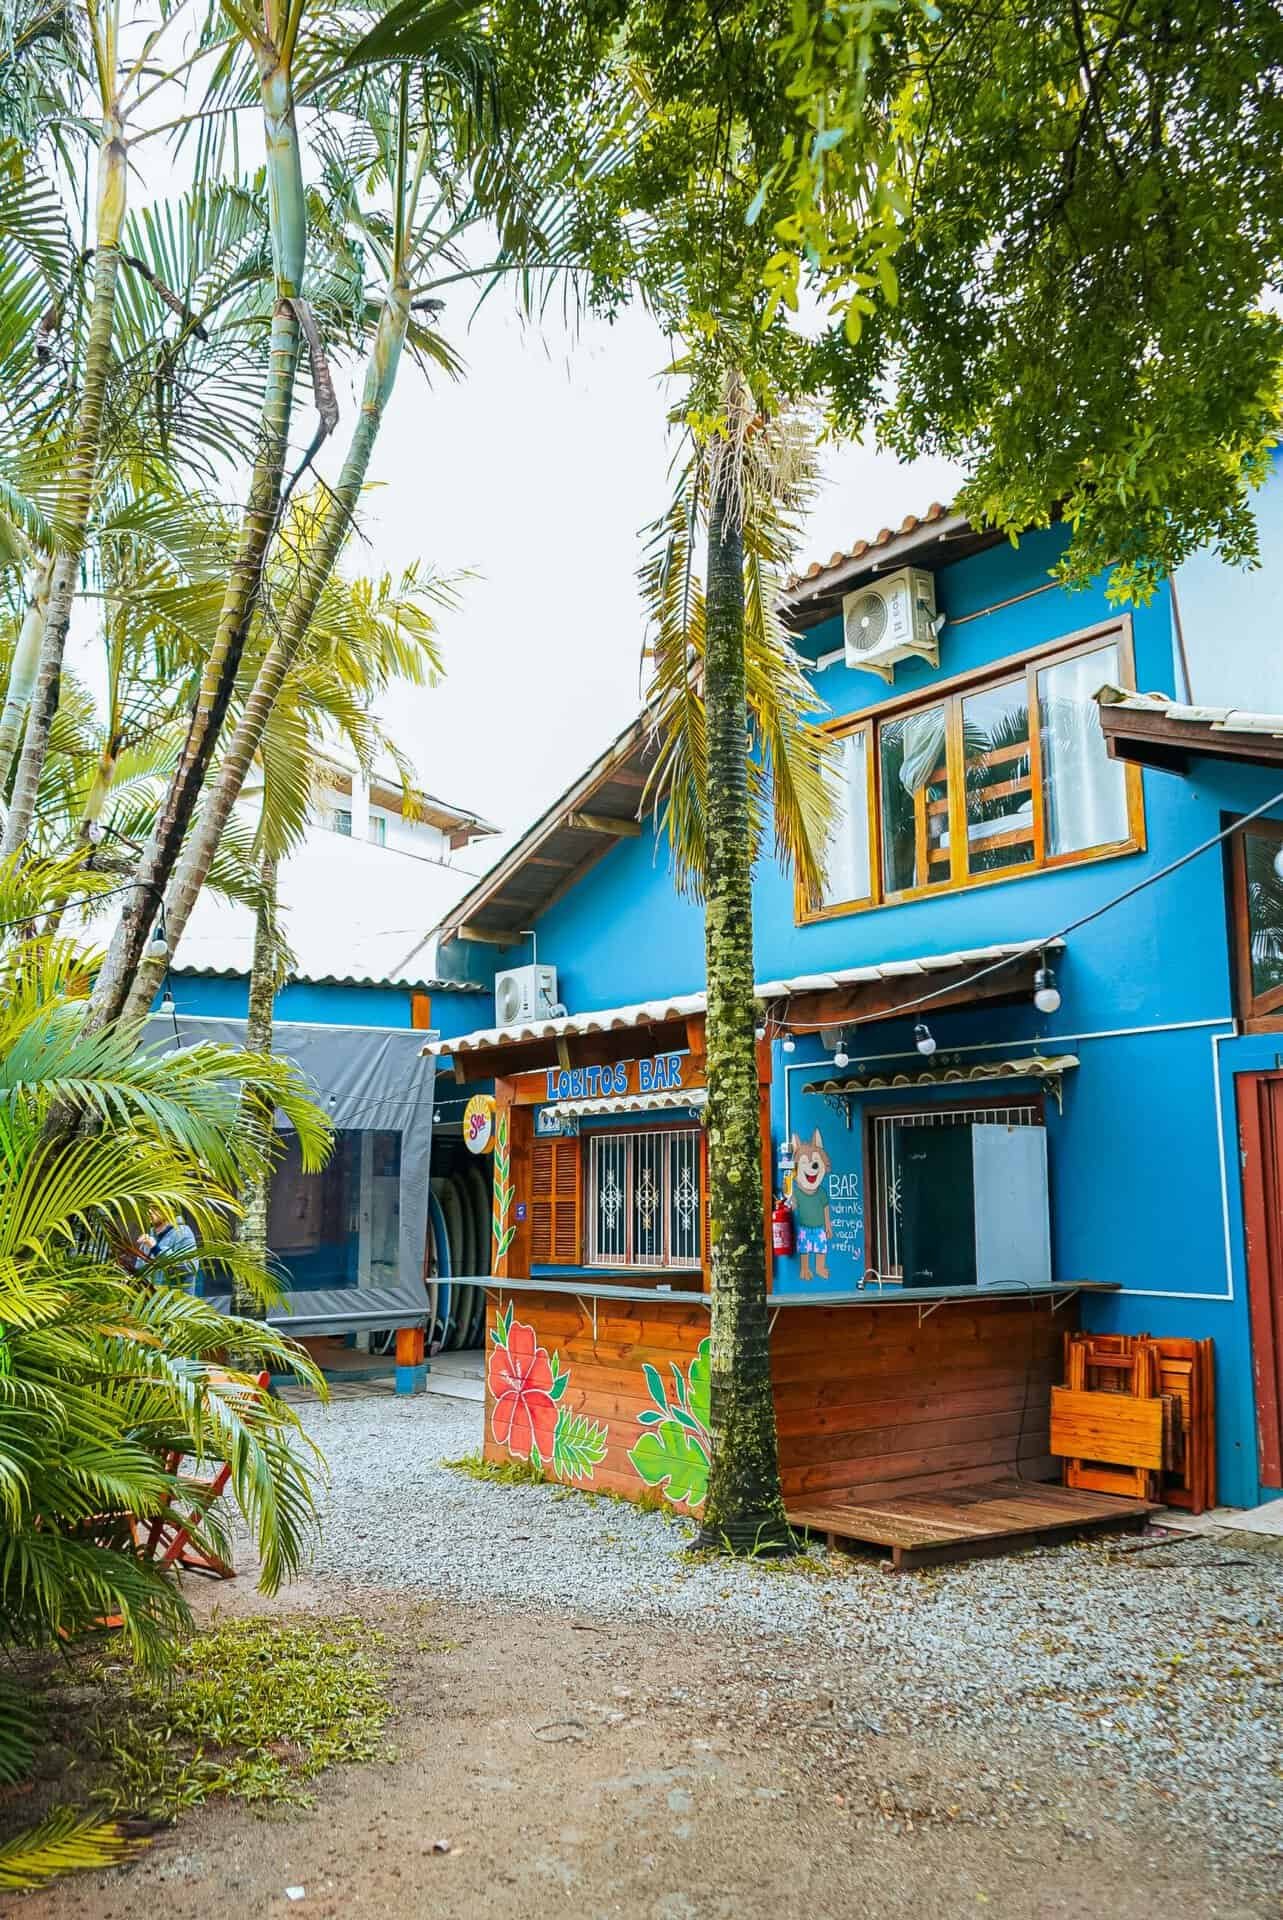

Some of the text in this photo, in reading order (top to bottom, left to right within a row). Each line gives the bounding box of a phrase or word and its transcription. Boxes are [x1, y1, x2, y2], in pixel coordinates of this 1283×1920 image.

[547, 1056, 682, 1100] LOBITOS BAR
[828, 1173, 859, 1197] BAR
